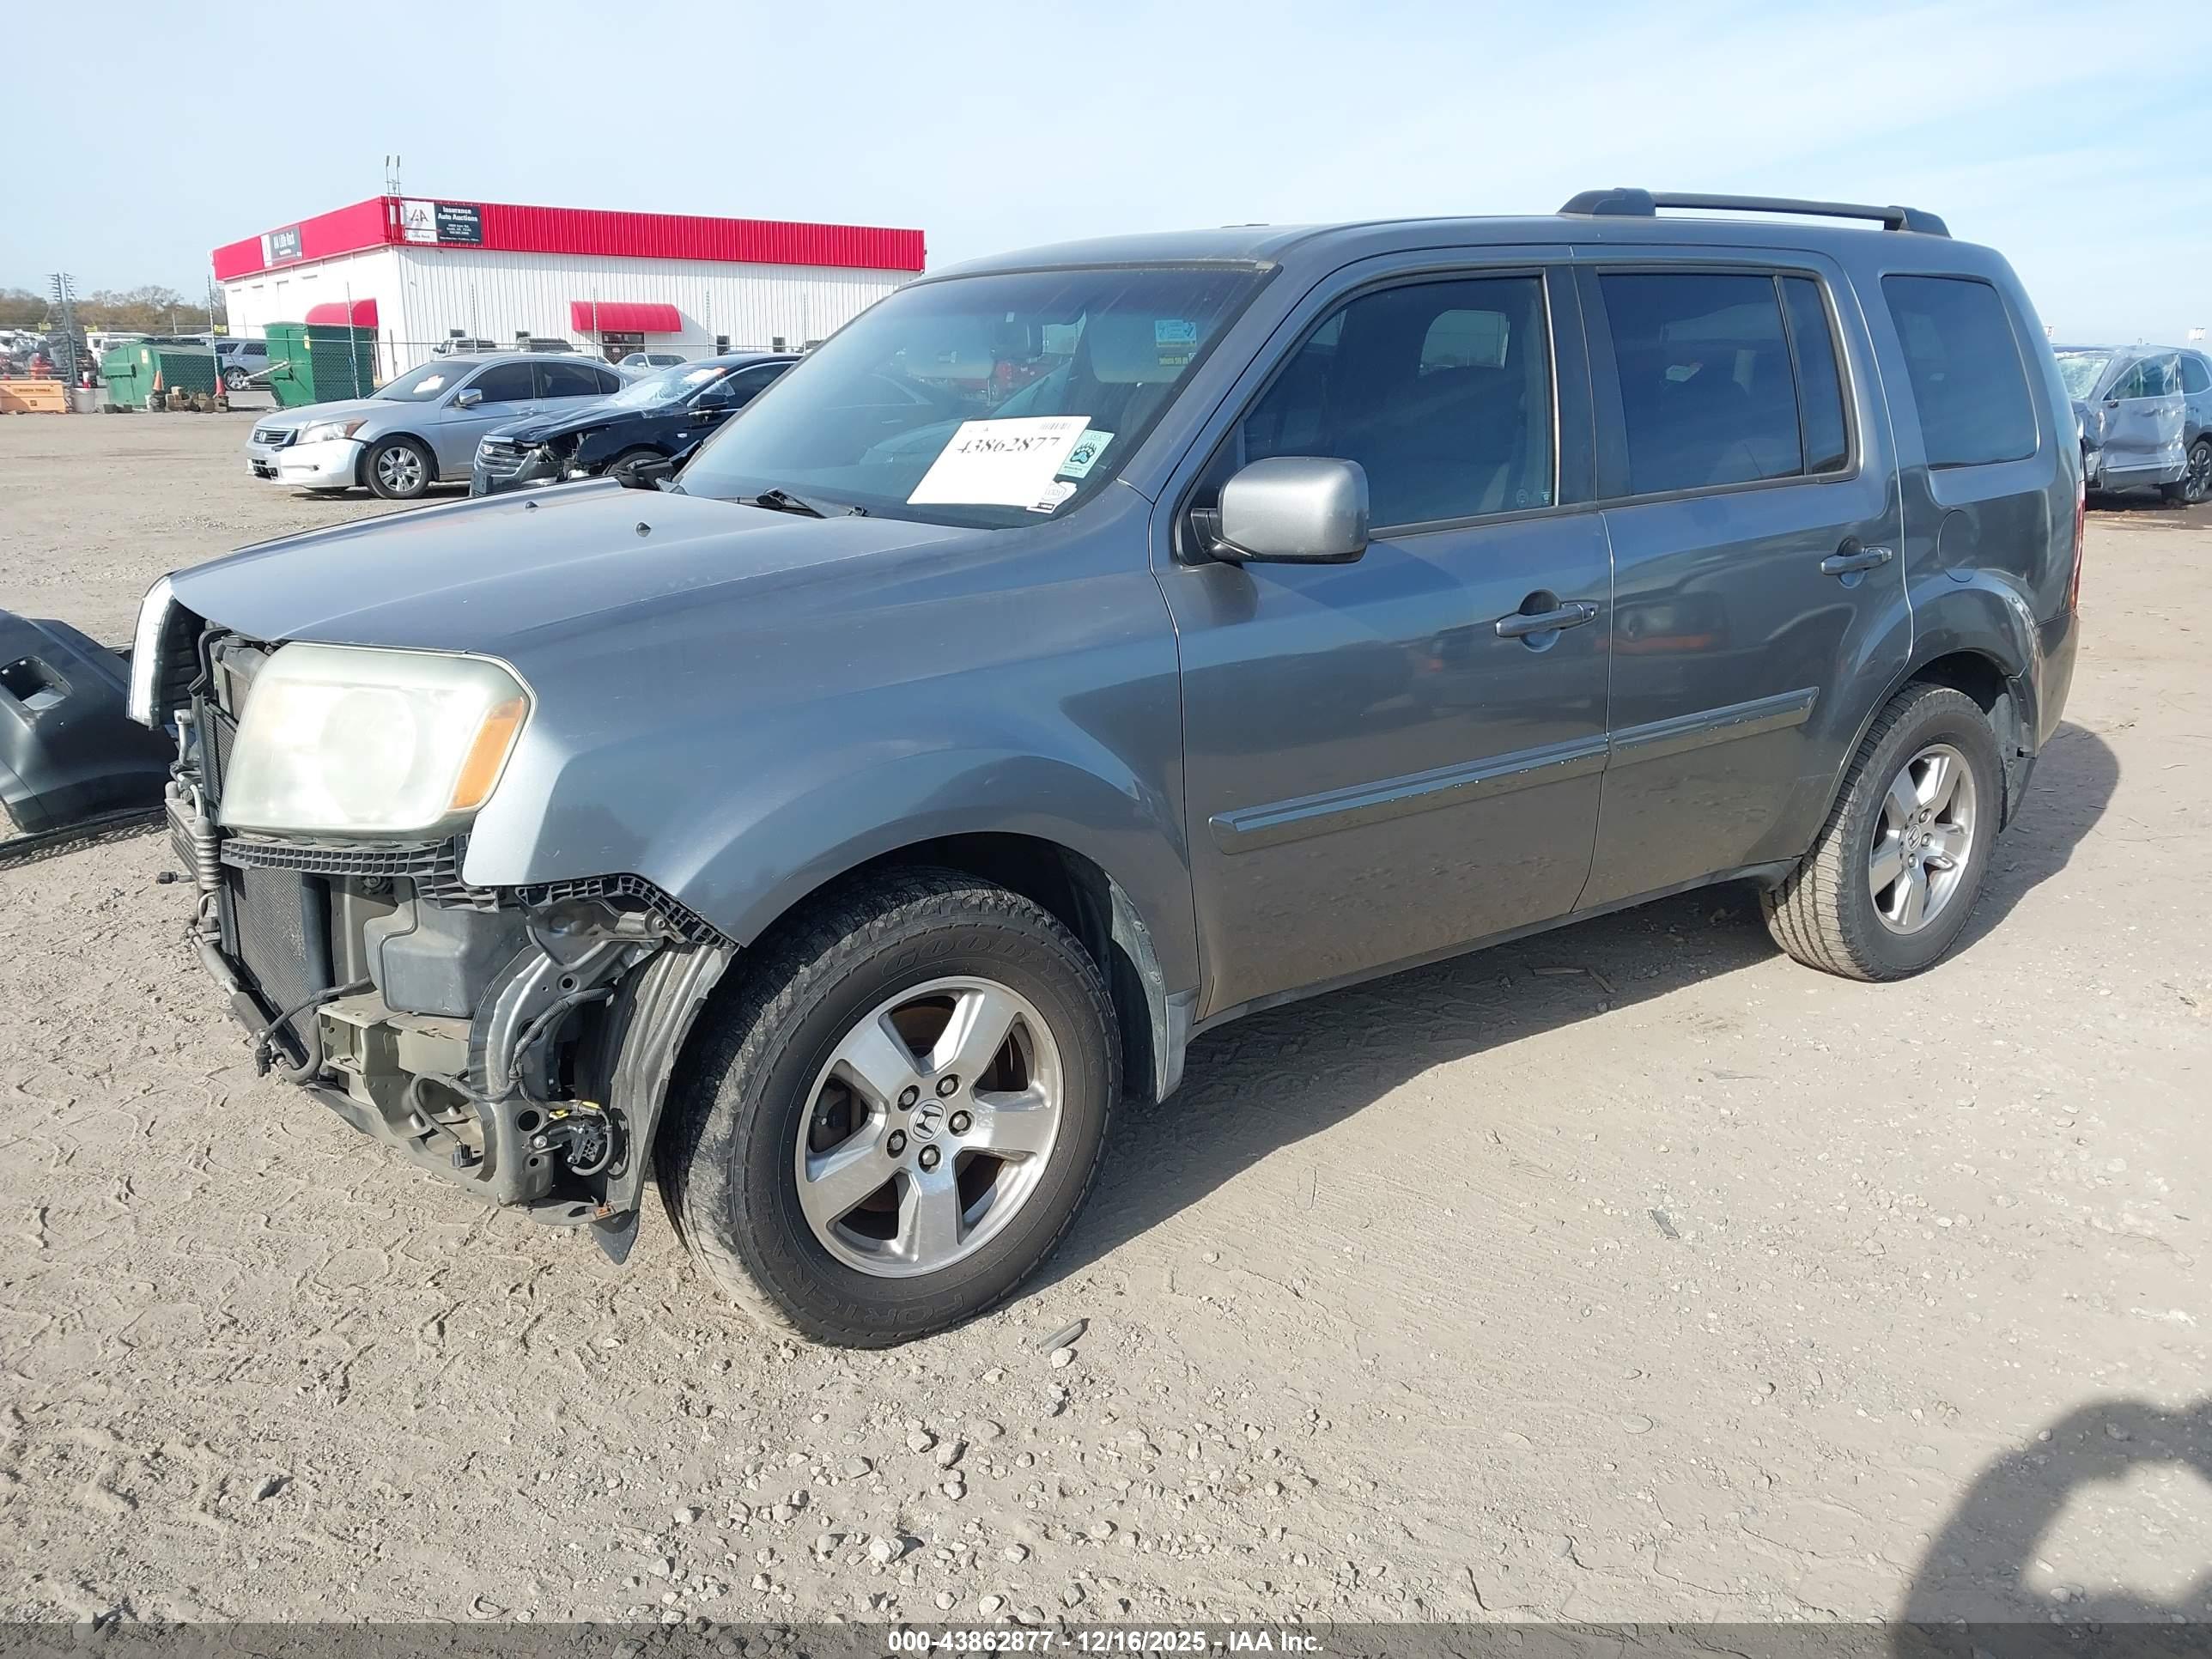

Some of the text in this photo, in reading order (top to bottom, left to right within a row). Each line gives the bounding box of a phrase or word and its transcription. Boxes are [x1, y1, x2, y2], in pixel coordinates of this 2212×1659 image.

[442, 205, 472, 215] Insurance
[453, 214, 478, 222] Auctions
[957, 436, 1062, 453] 43862877
[882, 934, 1109, 1079] GOODYEAR
